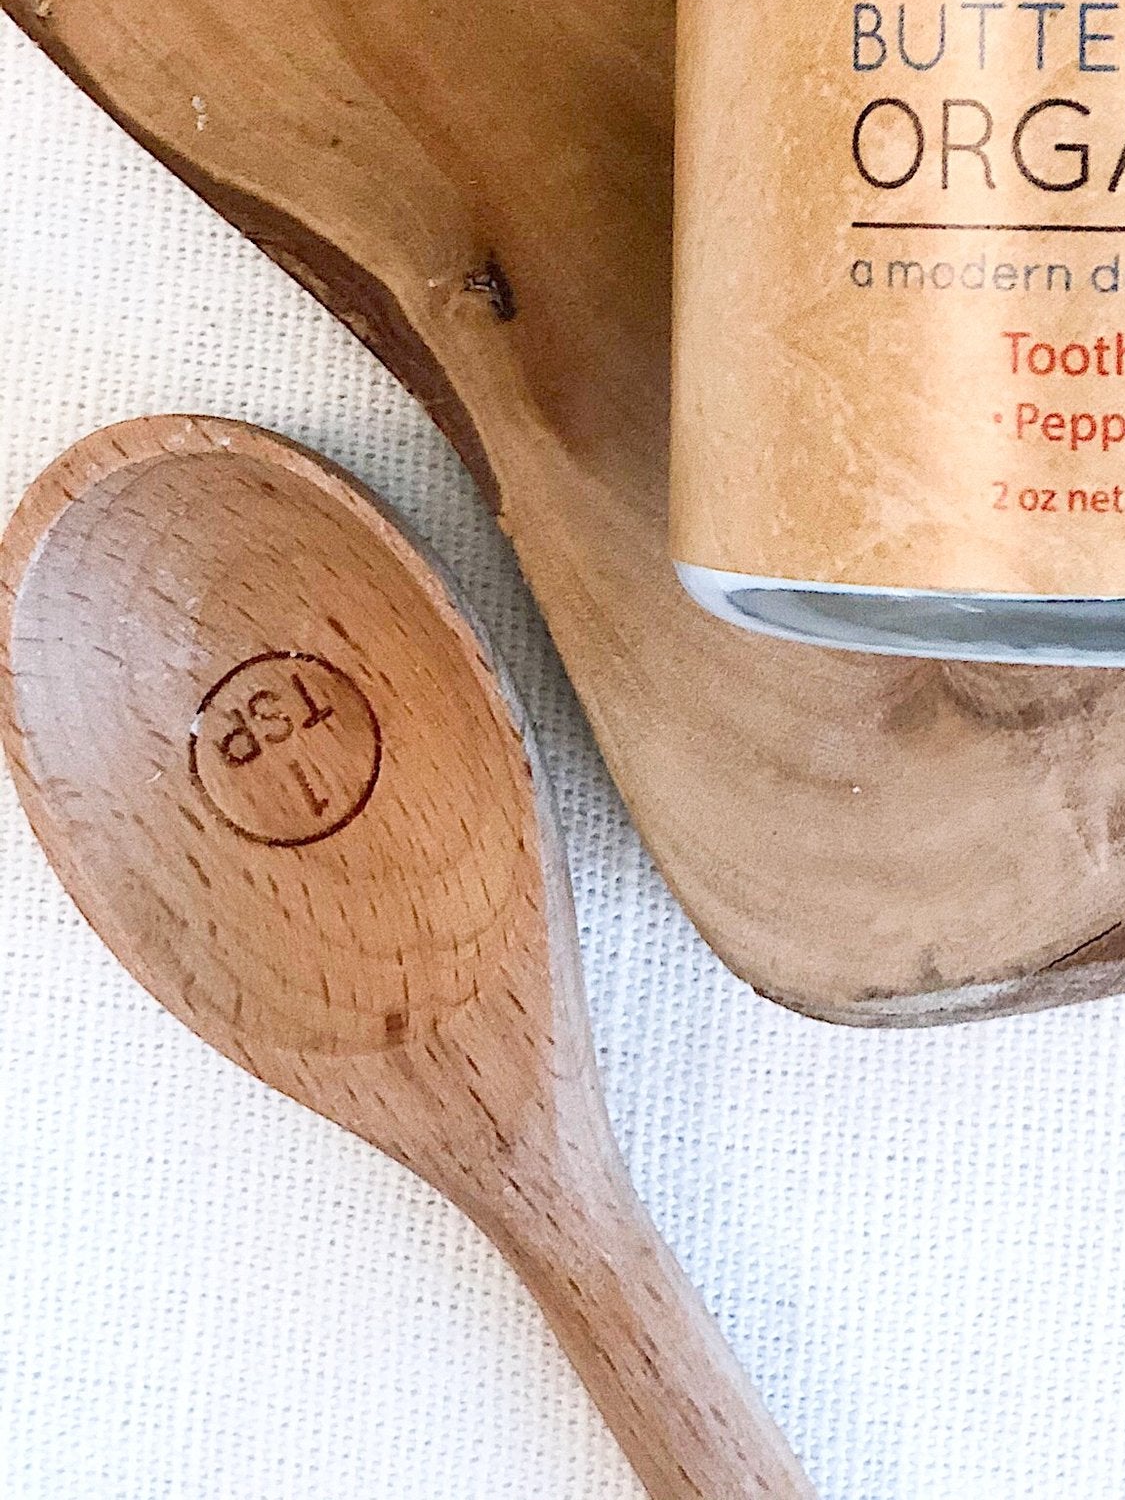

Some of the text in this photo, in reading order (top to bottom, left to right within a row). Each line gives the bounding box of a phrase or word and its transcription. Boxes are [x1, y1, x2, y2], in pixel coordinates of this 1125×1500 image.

[851, 259, 874, 288] a
[887, 254, 1073, 292] modern
[992, 482, 1010, 511] 2
[1018, 487, 1058, 513] oz
[1068, 484, 1124, 514] net
[218, 673, 335, 767] TSP
